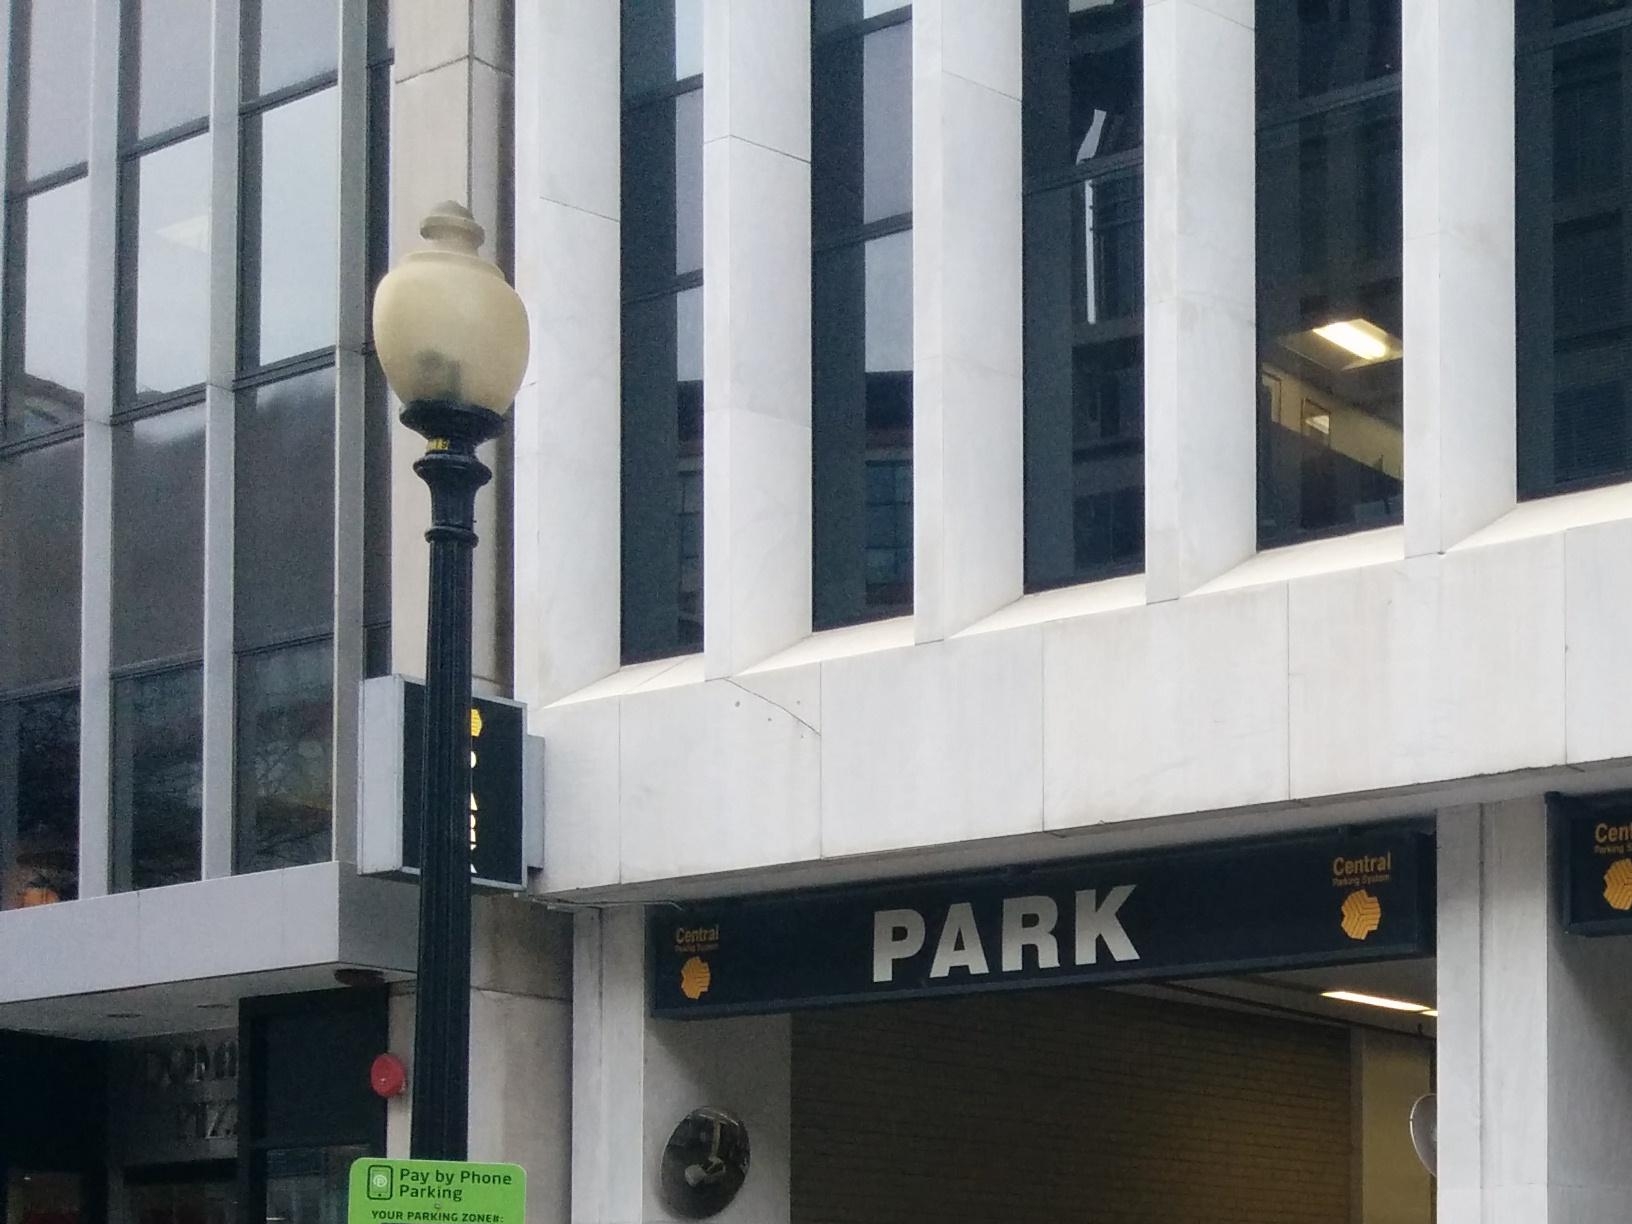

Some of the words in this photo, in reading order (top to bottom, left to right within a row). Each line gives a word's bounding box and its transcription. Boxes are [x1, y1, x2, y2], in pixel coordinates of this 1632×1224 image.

[1333, 851, 1392, 876] Central
[676, 923, 720, 944] Central
[873, 884, 1141, 983] PARK
[400, 1168, 429, 1185] Pay
[436, 1170, 455, 1186] by
[460, 1170, 512, 1185] Phone
[400, 1184, 463, 1201] Parking
[371, 1210, 404, 1220] YOUR
[407, 1212, 458, 1221] PARKING
